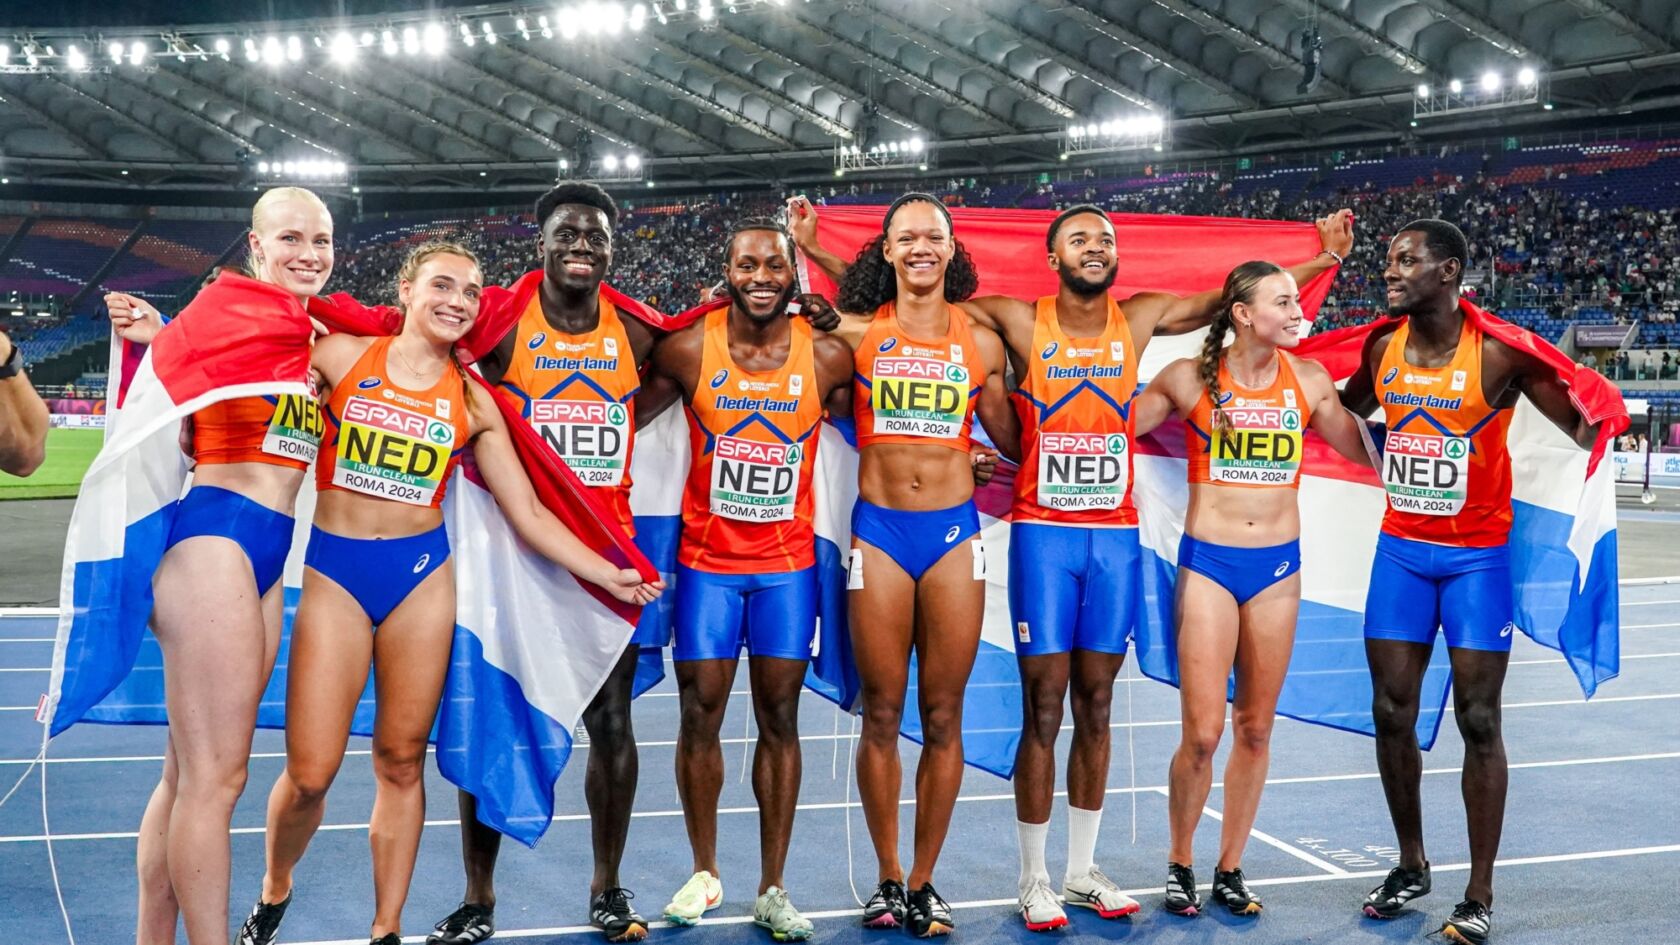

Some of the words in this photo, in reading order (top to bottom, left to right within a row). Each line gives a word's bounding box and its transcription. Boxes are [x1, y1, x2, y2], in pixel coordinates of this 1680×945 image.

[535, 355, 618, 371] Nederland
[877, 362, 943, 378] SPAR
[1047, 364, 1123, 379] Nederland
[716, 395, 798, 412] Nederland
[880, 380, 960, 414] NED
[1384, 391, 1462, 410] Nederland
[279, 393, 326, 438] NED
[347, 402, 425, 436] SPAR
[535, 404, 605, 421] SPAR
[895, 410, 914, 418] RUN
[1222, 411, 1279, 426] PAR
[886, 420, 920, 432] ROMA
[923, 423, 951, 435] 2024
[278, 440, 310, 457] ROMA
[541, 424, 621, 457] NED
[1043, 436, 1105, 452] SPAR
[1218, 432, 1295, 462] NED
[1387, 435, 1442, 455] SPAR
[344, 426, 438, 477] NED
[718, 440, 784, 463] SPAR
[358, 462, 381, 476] RUN
[564, 459, 579, 468] UN
[1046, 455, 1121, 485] NED
[1388, 454, 1458, 489] NED
[589, 470, 613, 482] 2024
[719, 459, 794, 496] NED
[1222, 469, 1258, 481] ROMA
[1261, 471, 1287, 482] 2024
[345, 473, 385, 493] ROMA
[389, 484, 422, 501] 2024
[1062, 486, 1080, 494] RUN
[1400, 487, 1415, 496] RUN
[733, 494, 752, 504] RUN
[1050, 496, 1086, 507] ROMA
[1089, 496, 1115, 506] 2024
[1391, 496, 1421, 509] ROMA
[1423, 500, 1453, 512] 2024
[721, 503, 757, 518] ROMA
[760, 507, 784, 519] 2024
